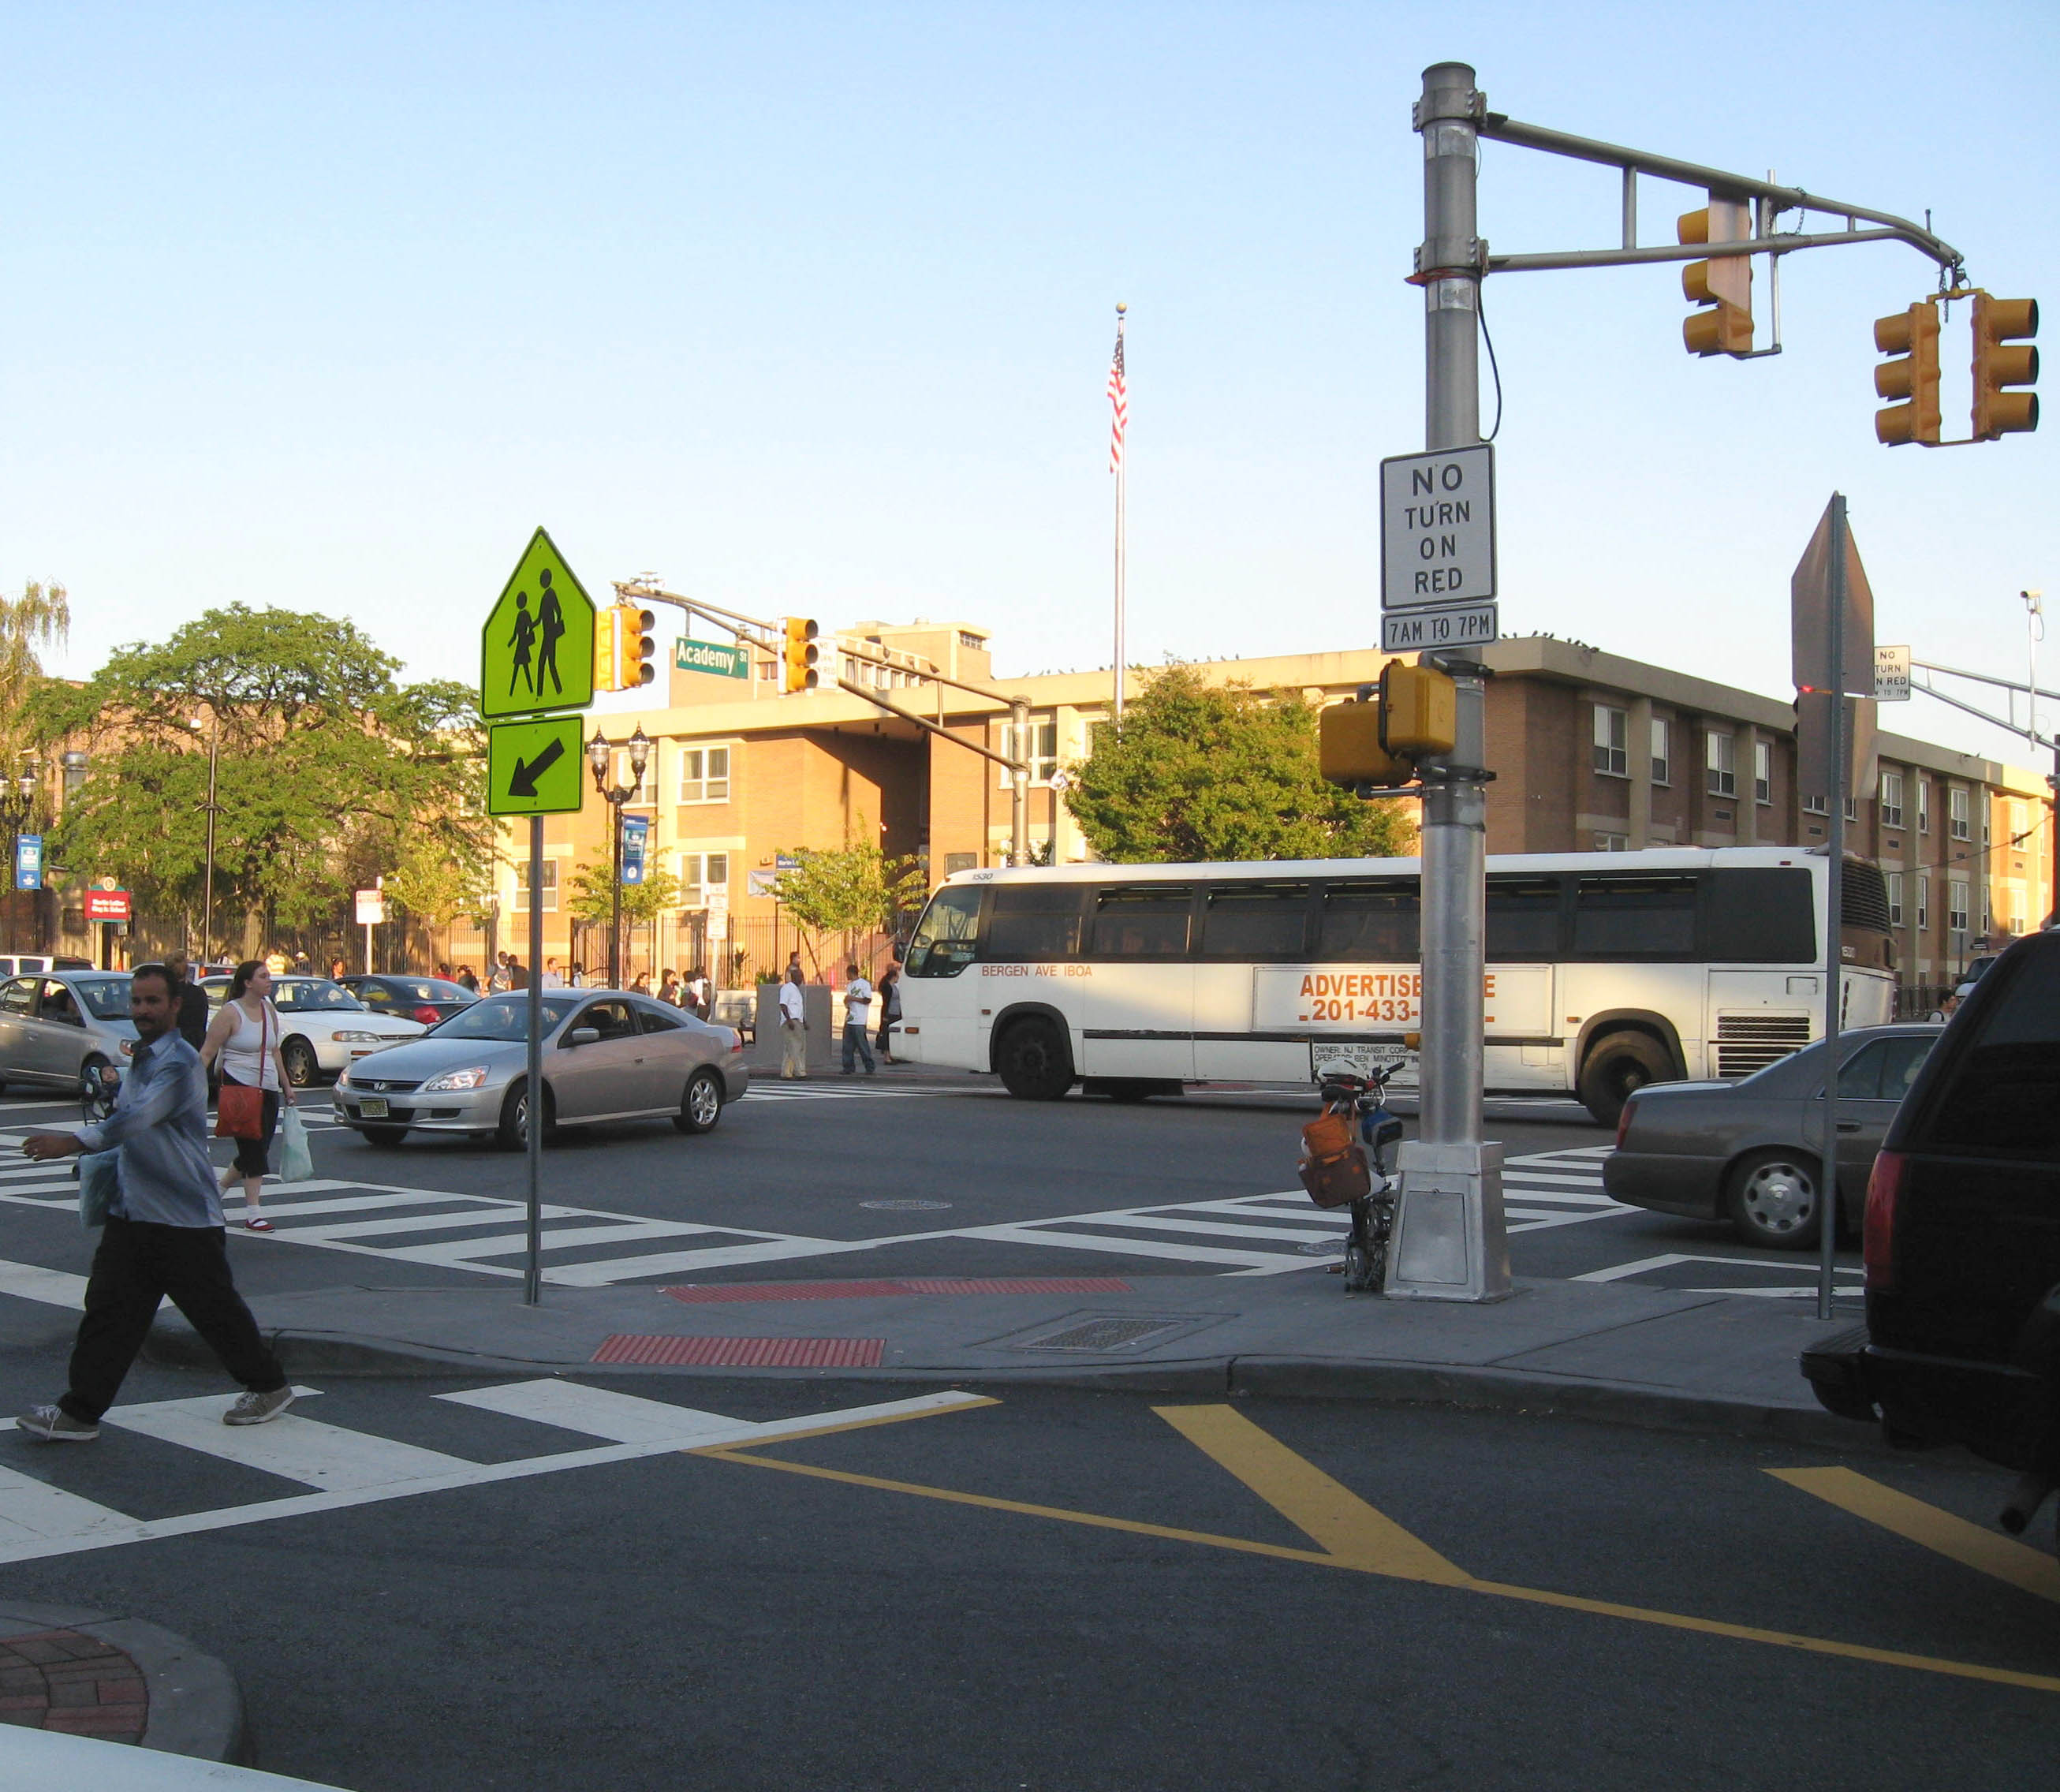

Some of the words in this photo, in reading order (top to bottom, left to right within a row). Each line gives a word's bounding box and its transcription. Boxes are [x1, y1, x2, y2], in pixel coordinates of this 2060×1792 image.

[1413, 464, 1463, 496] NO
[1405, 500, 1470, 529] TURN
[1420, 534, 1455, 560] ON
[1415, 567, 1463, 594] RED
[1390, 620, 1422, 644] 7AM
[1431, 618, 1450, 640] TO
[1458, 614, 1489, 637] 7PM
[819, 641, 828, 650] NO
[1879, 651, 1895, 659] NO
[677, 640, 735, 674] Academy
[739, 650, 748, 663] St
[1874, 664, 1901, 673] TURN
[1875, 677, 1883, 685] N
[1886, 676, 1906, 685] RED
[972, 872, 994, 881] 1530
[982, 965, 1028, 976] BERGEN
[1035, 965, 1058, 976] AVE
[1064, 965, 1092, 976] IBOA
[1300, 974, 1420, 997] ADVERTISE
[1312, 999, 1419, 1021] 201-433-
